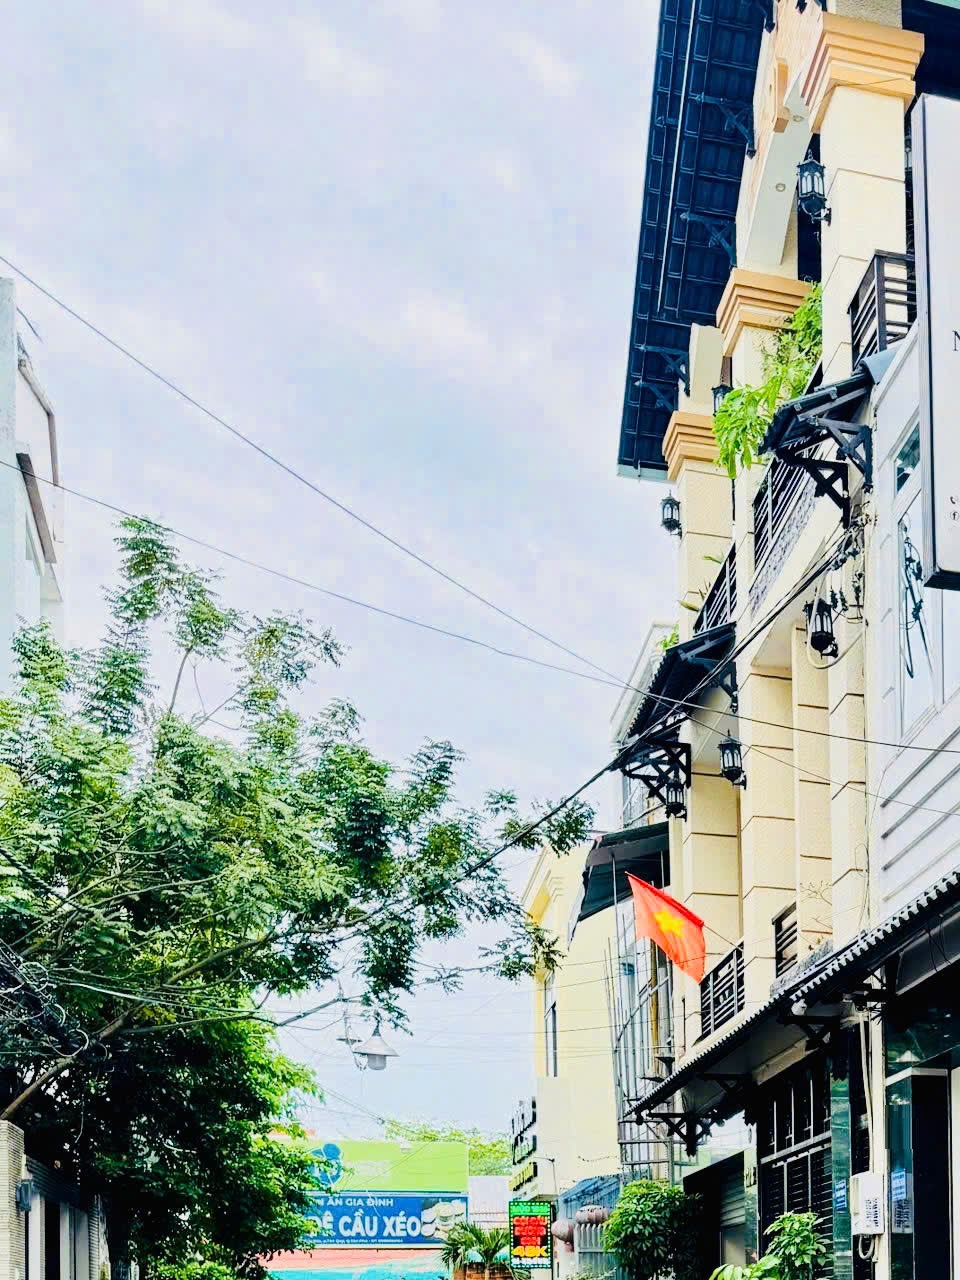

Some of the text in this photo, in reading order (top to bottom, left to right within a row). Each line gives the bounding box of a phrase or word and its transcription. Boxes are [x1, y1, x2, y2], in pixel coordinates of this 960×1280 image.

[345, 1198, 364, 1207] GIA
[339, 1208, 378, 1238] CẦU
[382, 1210, 421, 1238] XÉO
